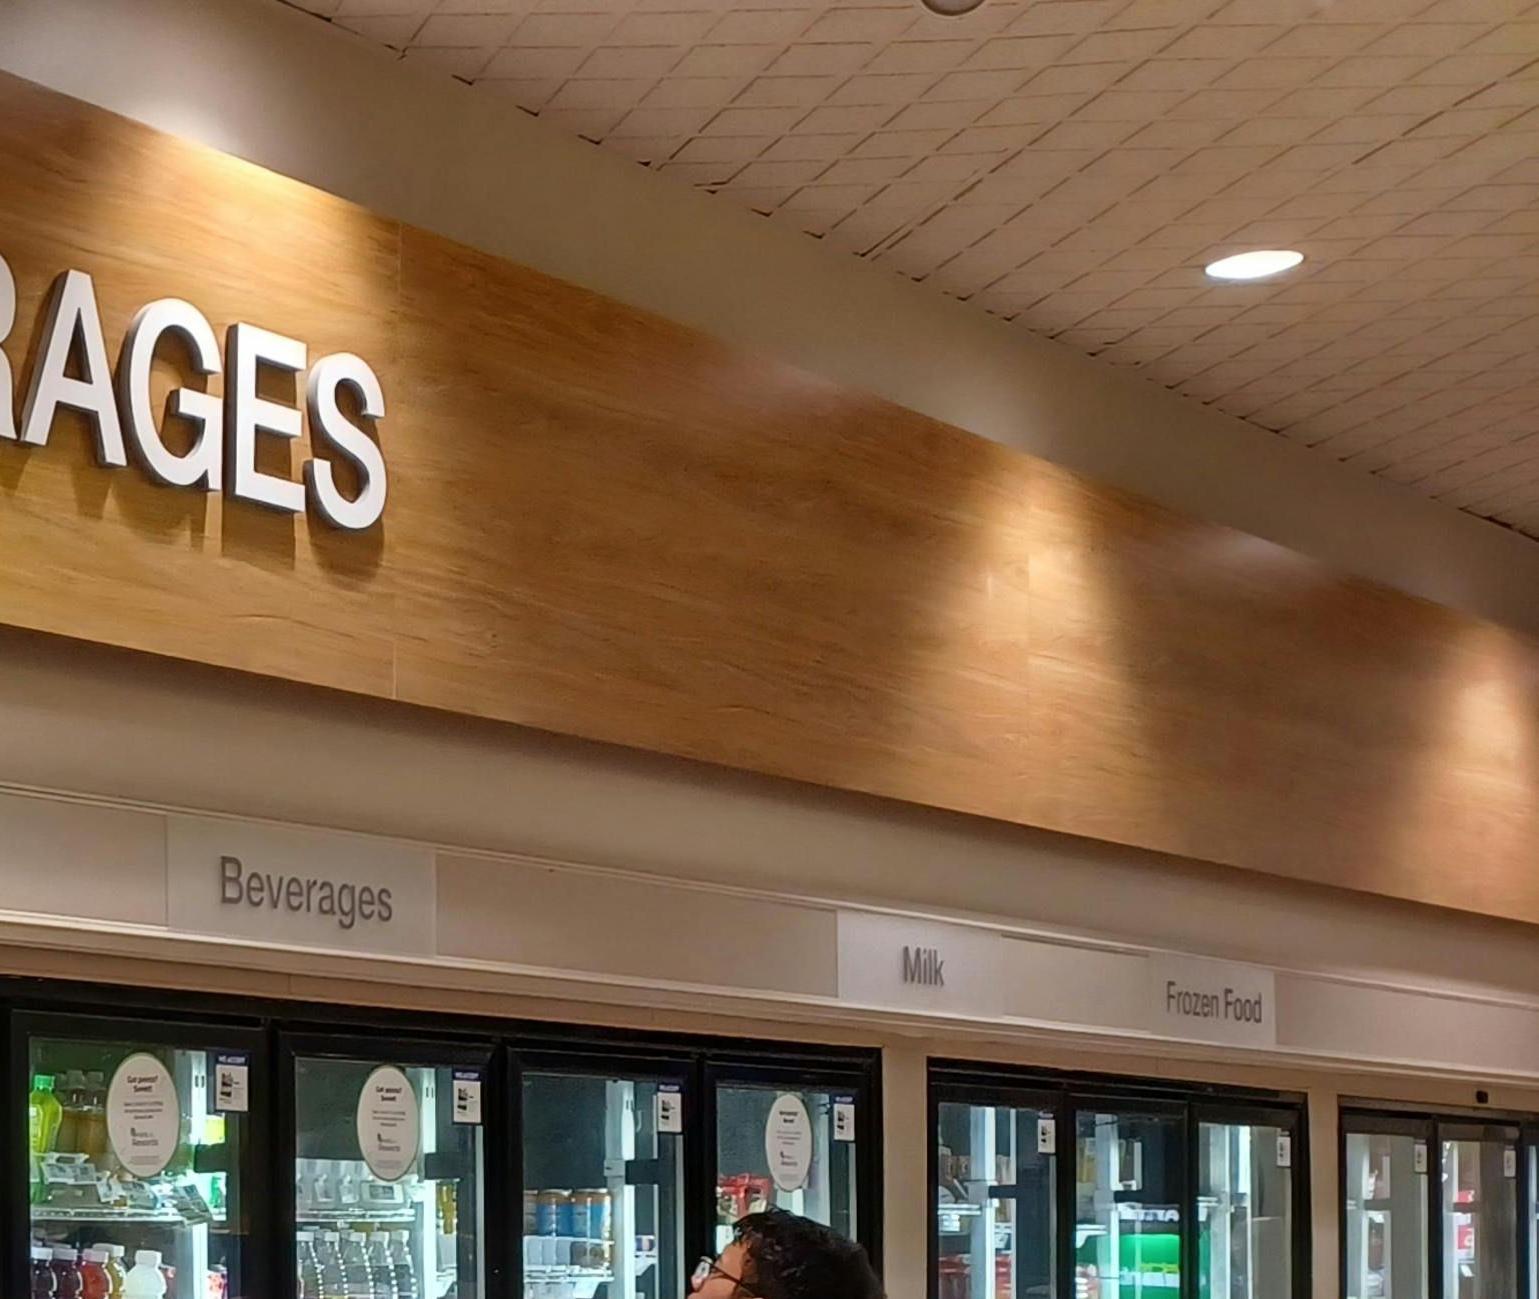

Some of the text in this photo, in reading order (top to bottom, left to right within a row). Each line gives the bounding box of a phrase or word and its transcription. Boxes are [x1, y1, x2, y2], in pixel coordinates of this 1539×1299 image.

[221, 856, 392, 929] Beverages
[902, 946, 945, 986] Milk
[1167, 981, 1262, 1023] Frozen Food
